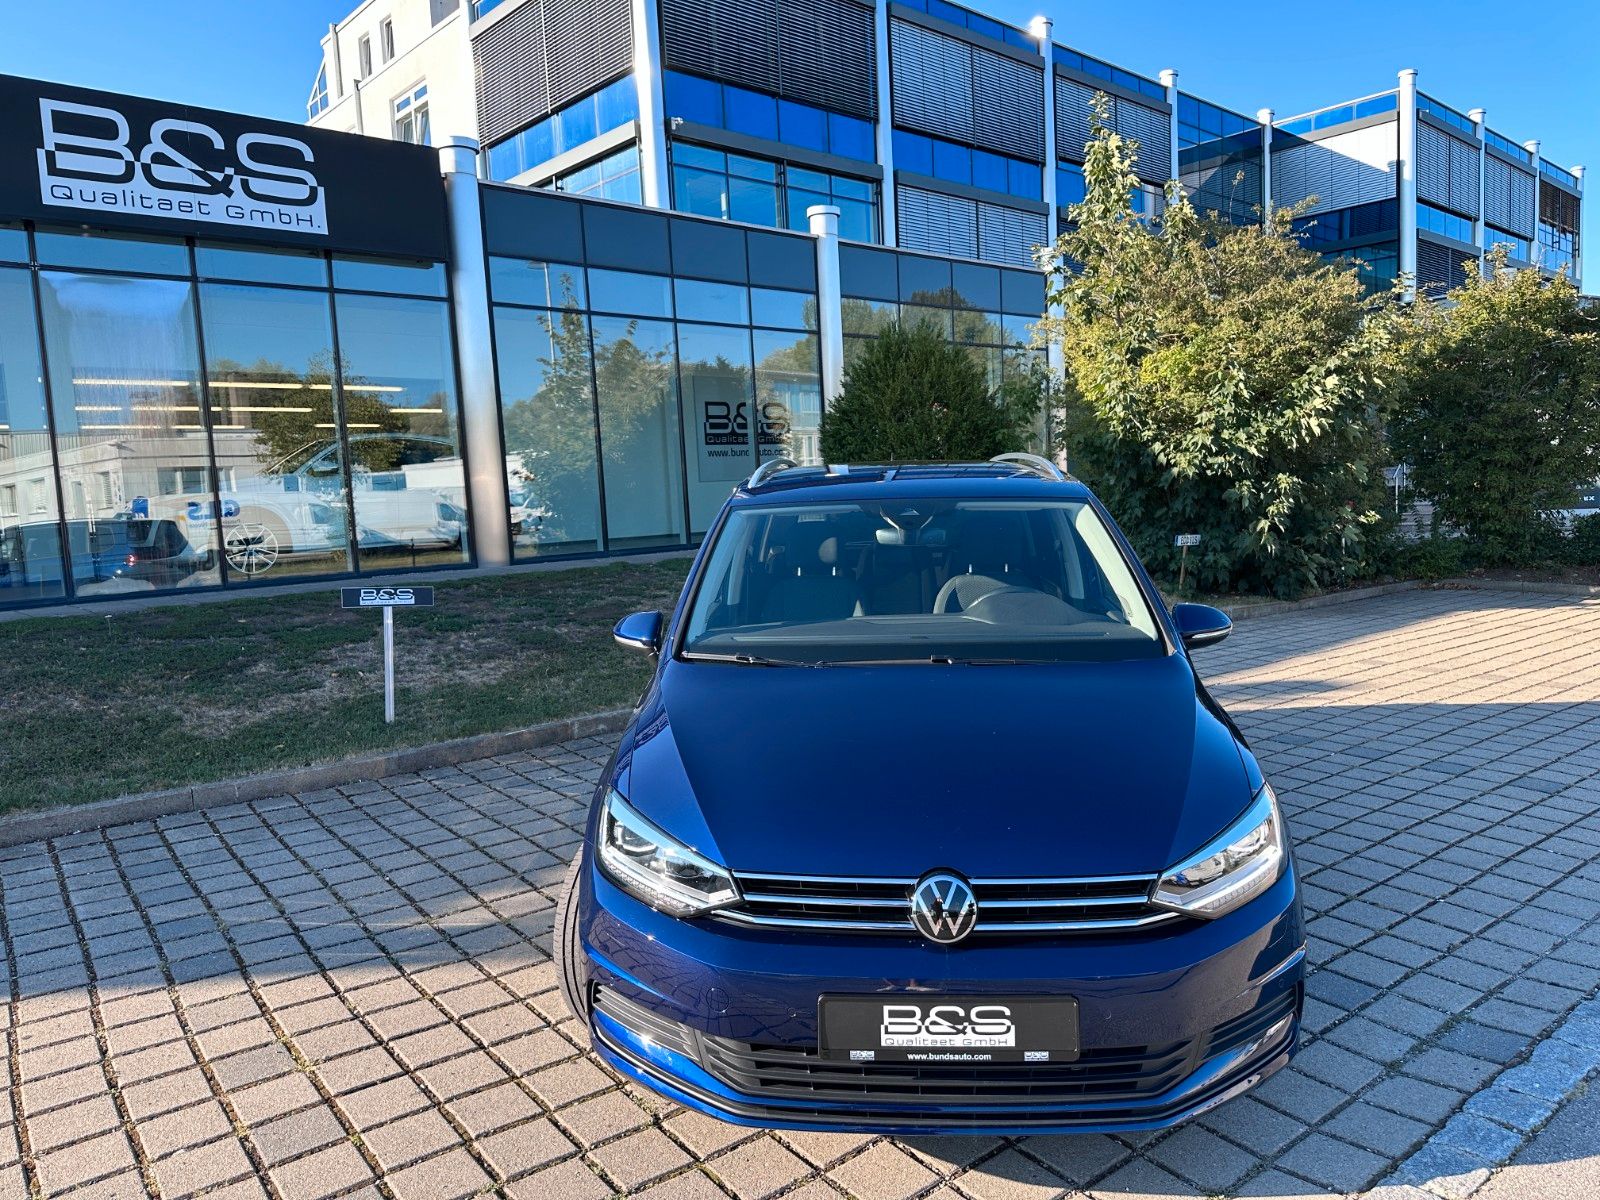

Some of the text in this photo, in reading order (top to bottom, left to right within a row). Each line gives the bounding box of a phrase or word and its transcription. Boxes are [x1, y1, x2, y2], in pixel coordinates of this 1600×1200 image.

[38, 98, 318, 206] B&S
[50, 184, 321, 229] Qualitaet GmbH.
[706, 434, 748, 443] Qualitae
[360, 588, 414, 600] B&S
[882, 1005, 1012, 1036] B&S
[884, 1037, 1008, 1046] Qualitaet GmbH
[907, 1052, 992, 1060] www.bundsauto.com
